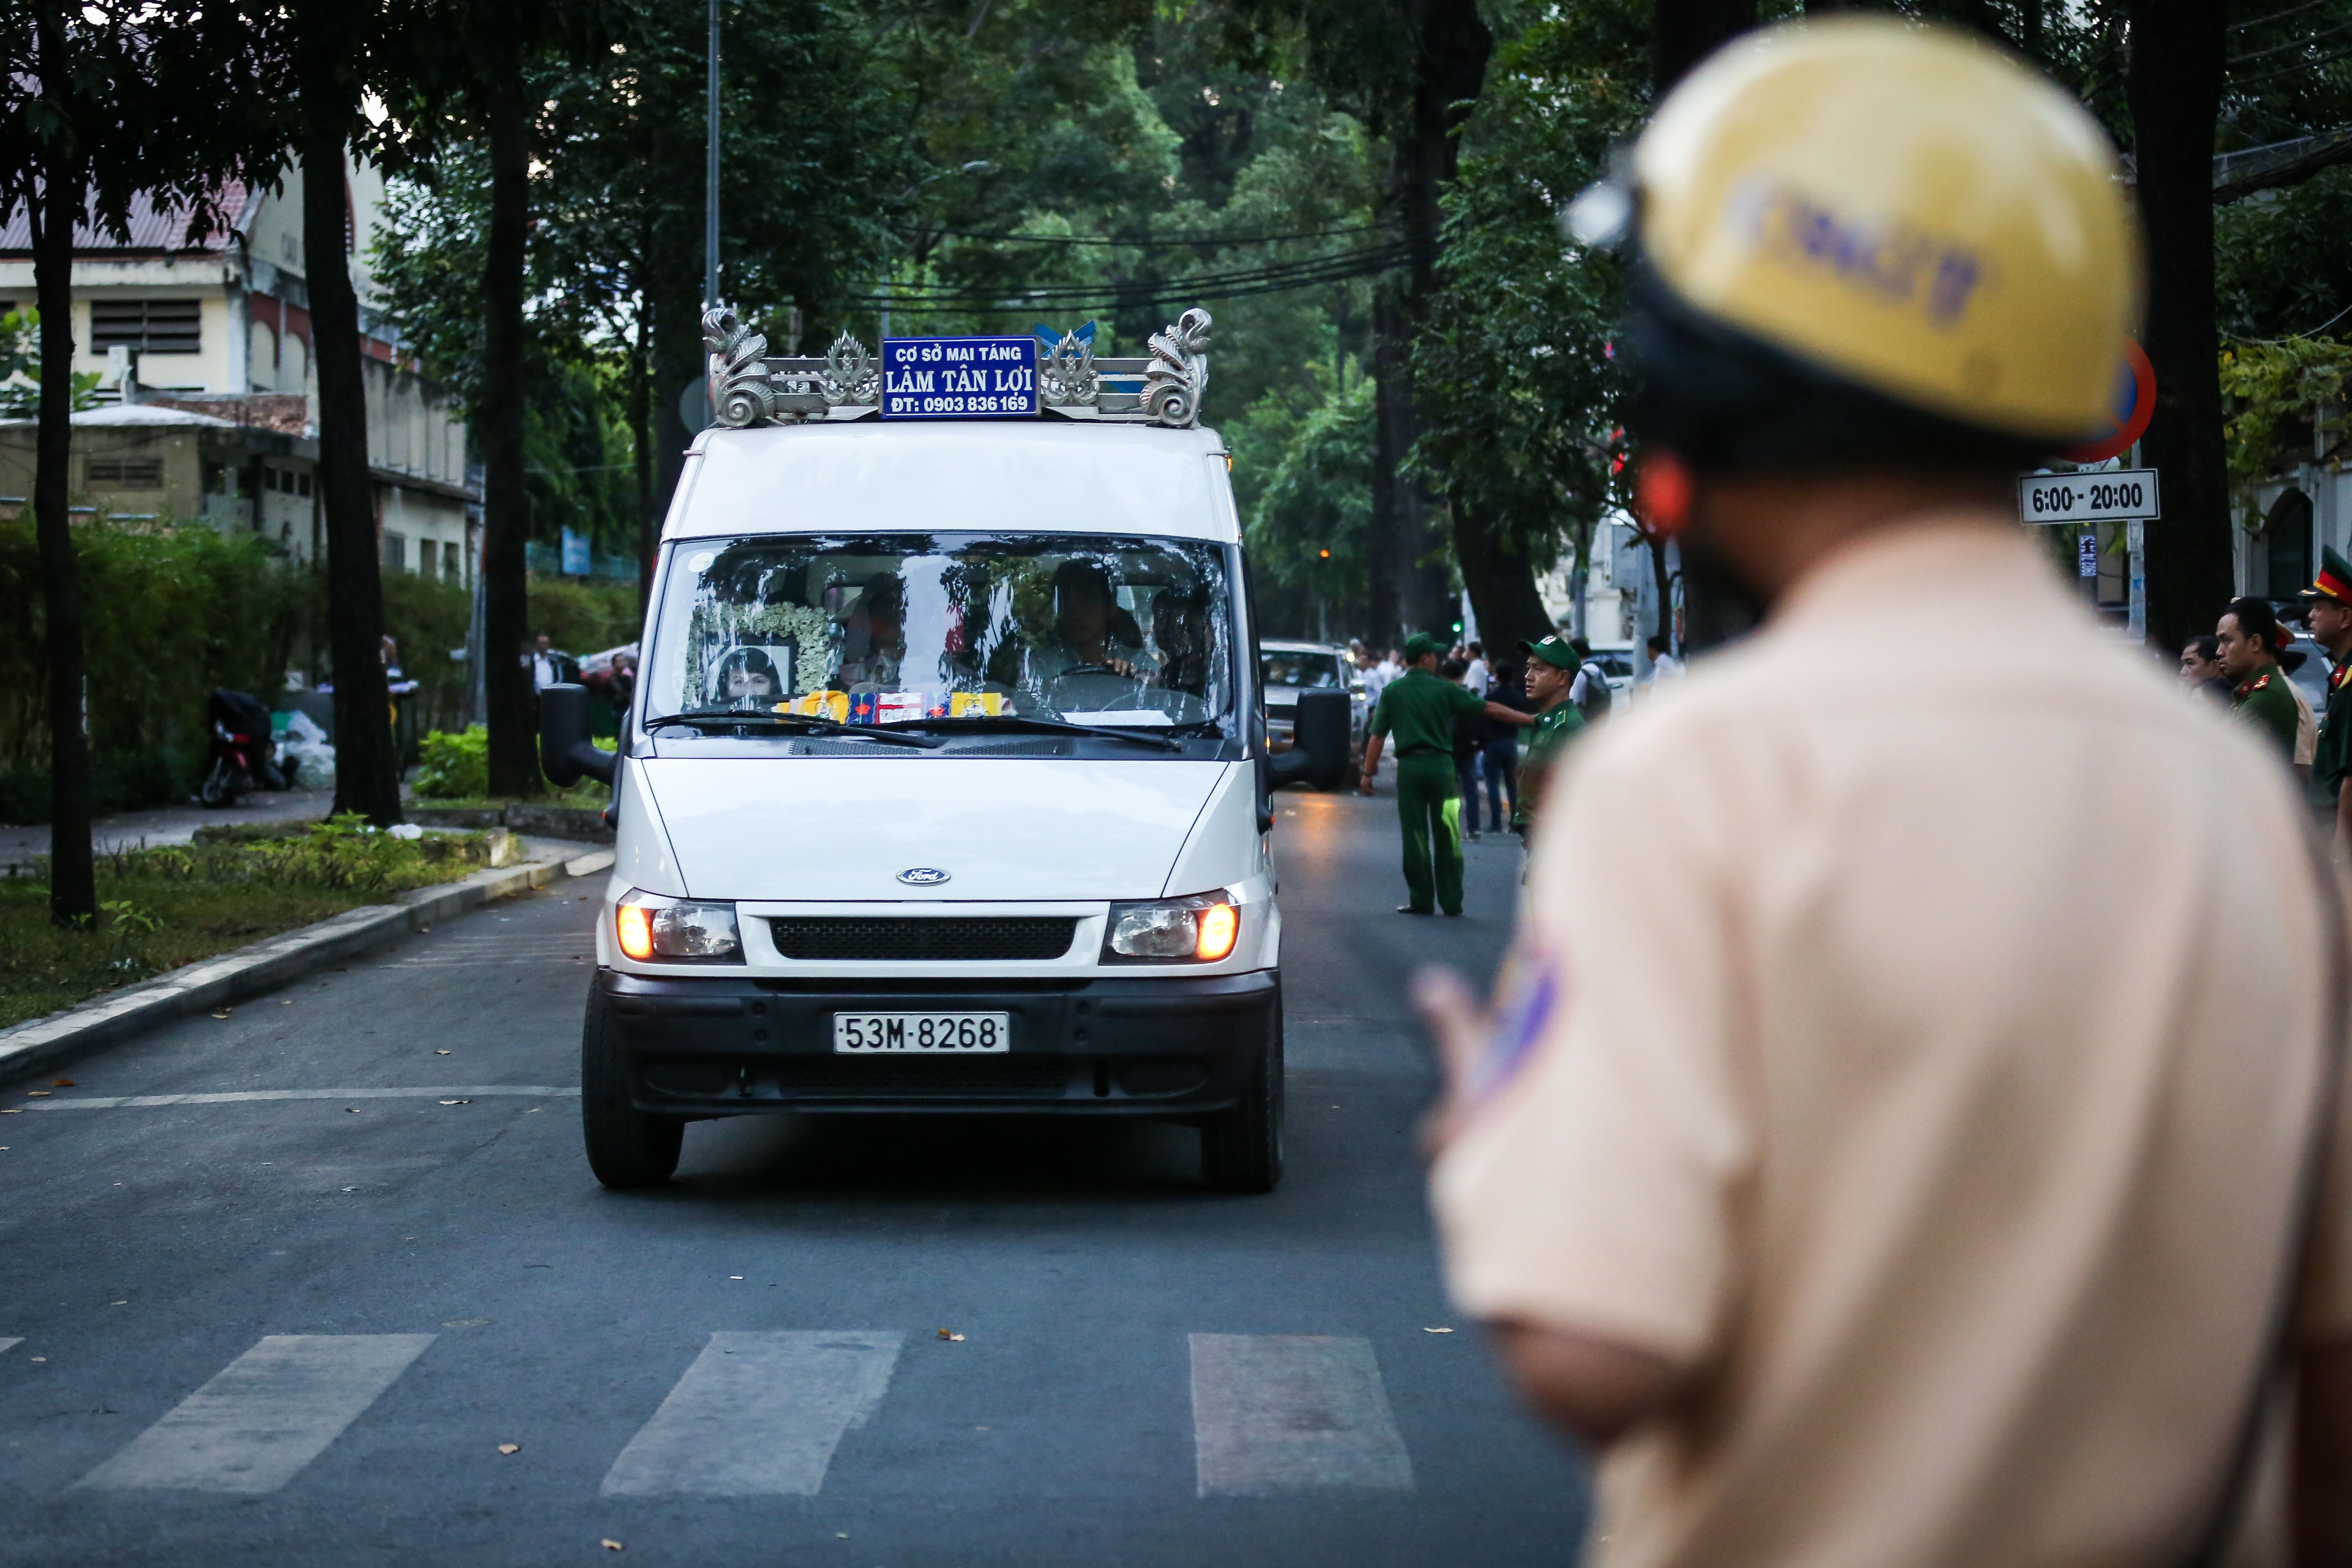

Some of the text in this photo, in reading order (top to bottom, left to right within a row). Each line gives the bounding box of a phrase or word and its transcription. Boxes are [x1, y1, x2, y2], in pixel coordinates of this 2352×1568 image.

[896, 344, 1021, 362] CƠ SỞ MAI TÁNG
[886, 364, 1032, 396] LÂM TÂN LỢI
[891, 396, 1028, 412] ĐT: 0903 836 169
[2090, 483, 2143, 510] 20:00
[908, 869, 939, 880] Ford
